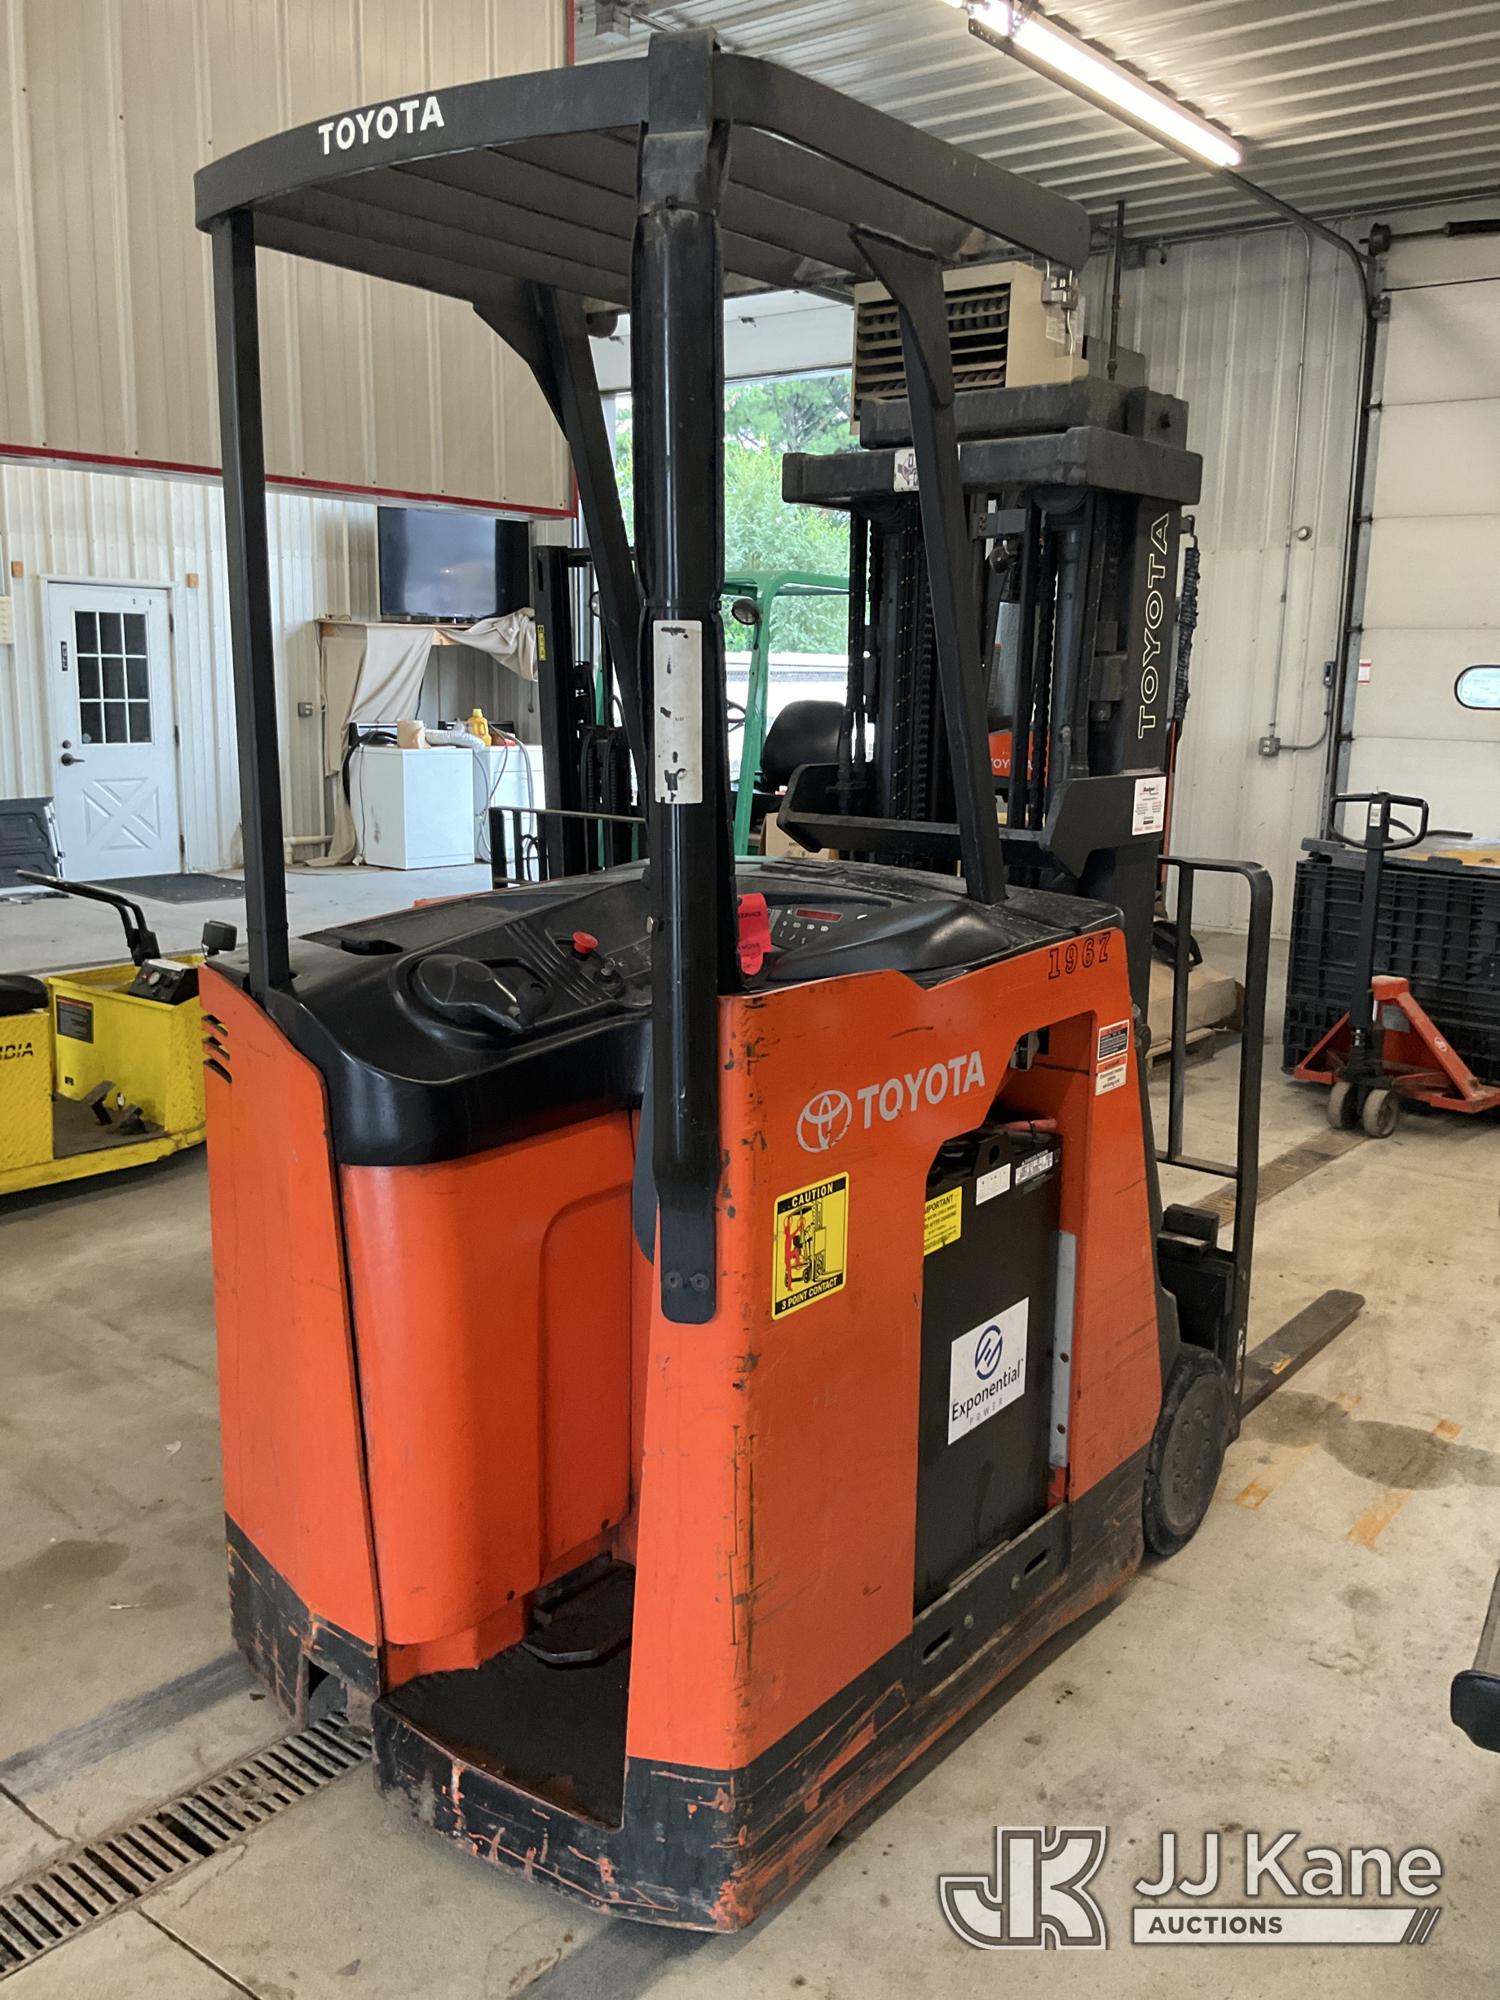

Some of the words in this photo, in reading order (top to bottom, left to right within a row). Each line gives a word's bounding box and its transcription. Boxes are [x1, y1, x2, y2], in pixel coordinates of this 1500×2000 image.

[318, 96, 445, 155] TOYOTA
[1138, 512, 1170, 739] TOYOTA
[1047, 932, 1111, 980] 1967
[857, 1050, 986, 1130] TOYOTA
[791, 1182, 834, 1207] CAUTION
[781, 1300, 787, 1310] 3
[788, 1289, 808, 1307] POINT
[808, 1277, 838, 1298] CONTACT
[952, 1359, 1021, 1422] Exponential
